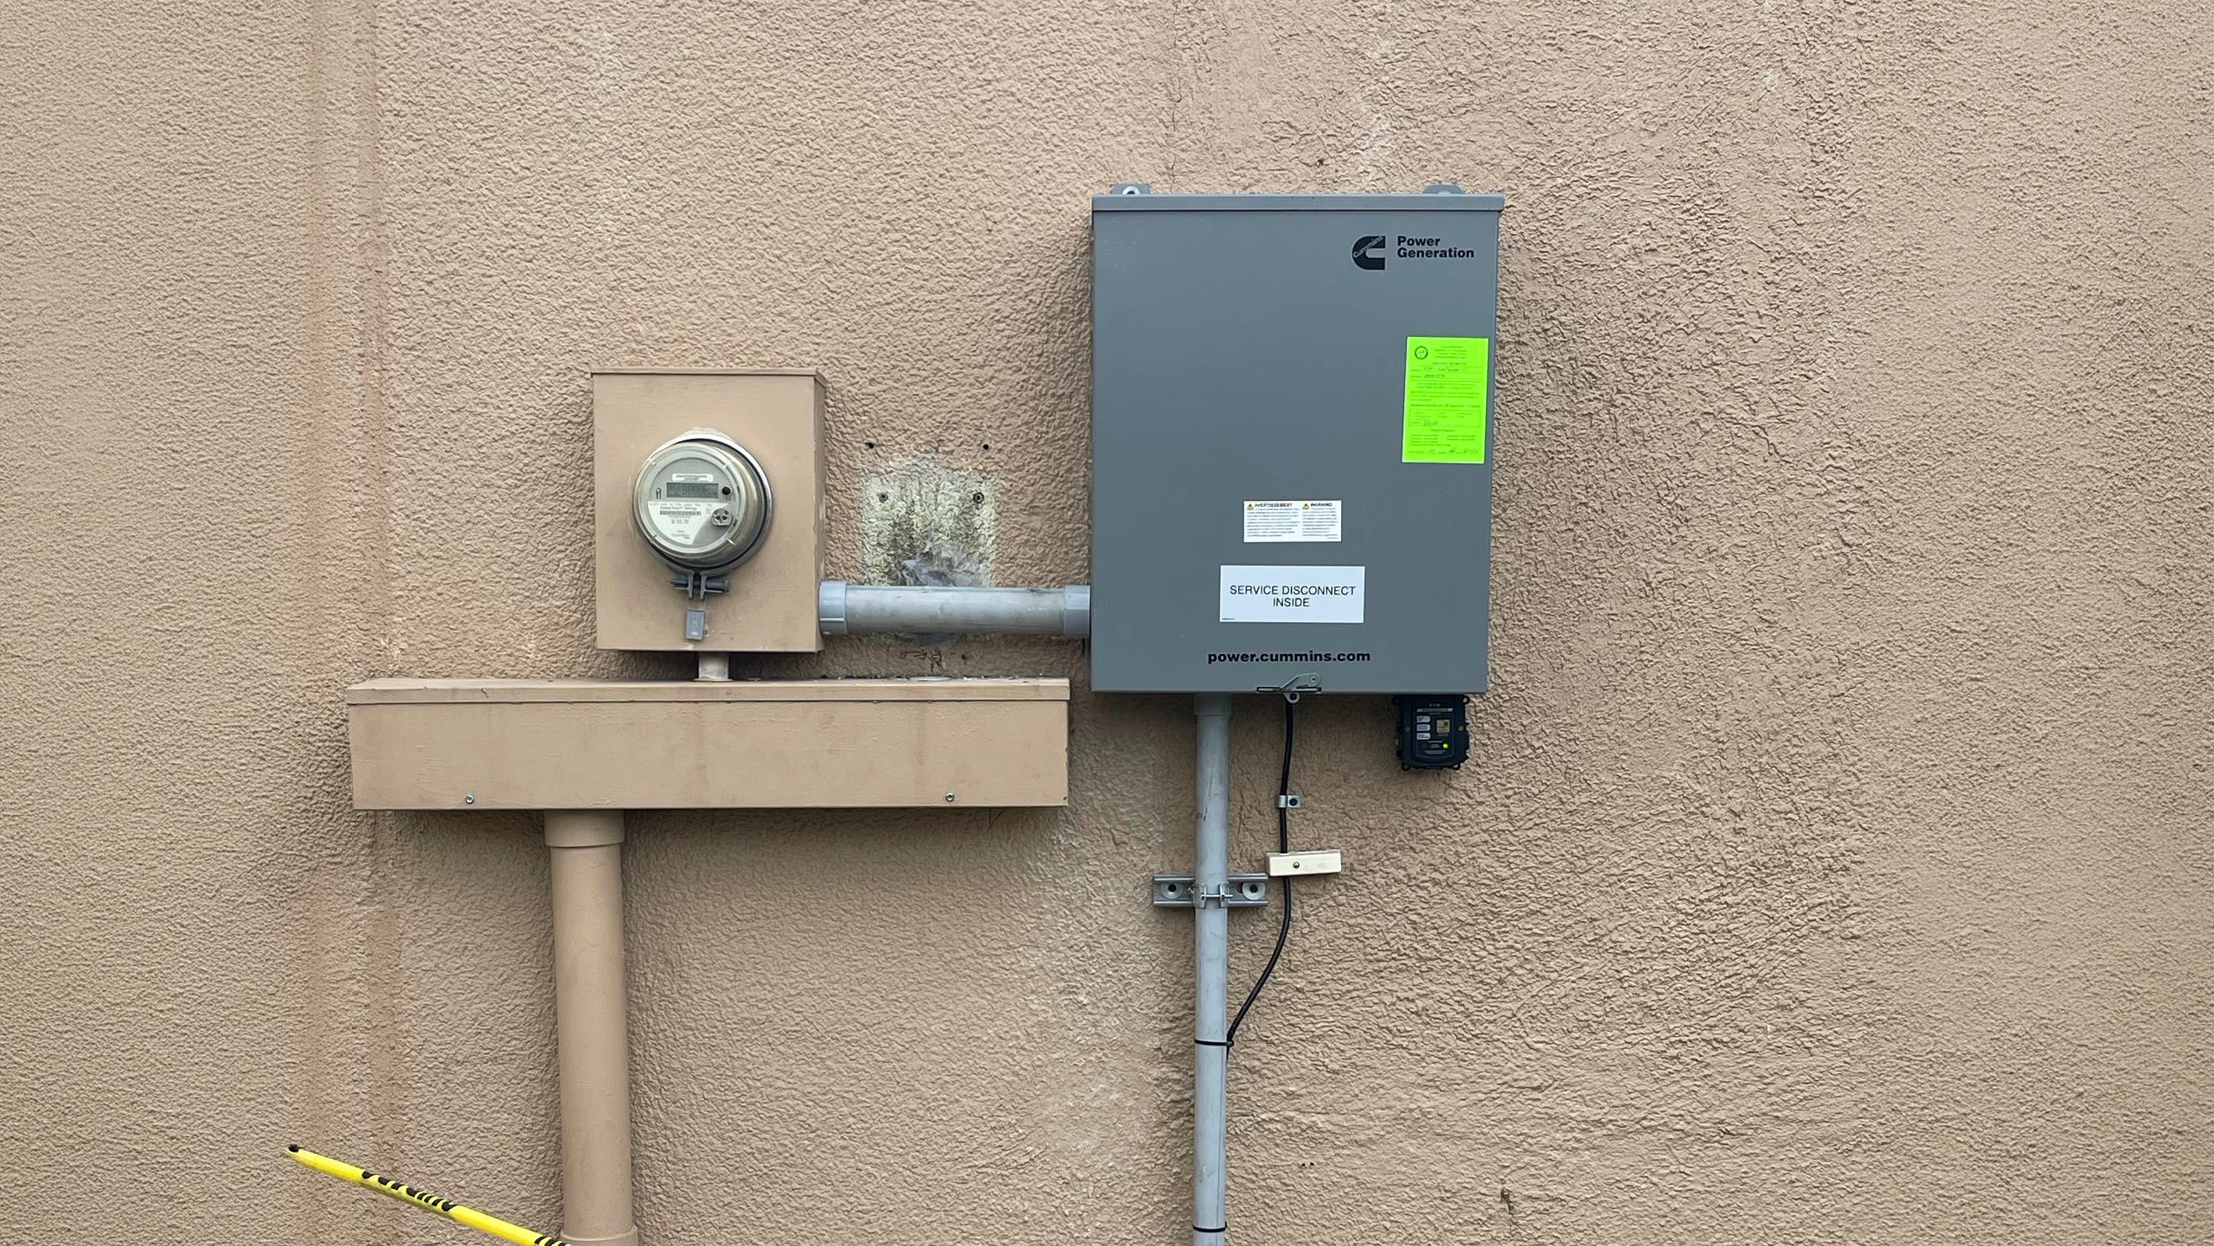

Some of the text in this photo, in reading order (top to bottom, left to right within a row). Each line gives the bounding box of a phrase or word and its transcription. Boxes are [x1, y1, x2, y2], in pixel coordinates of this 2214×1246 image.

[1397, 235, 1441, 247] Power
[1397, 247, 1475, 258] Generation
[1229, 585, 1356, 596] SERVICE DISCONNECT
[1272, 597, 1310, 608] INSIDE
[1207, 649, 1371, 664] power.cummins.com
